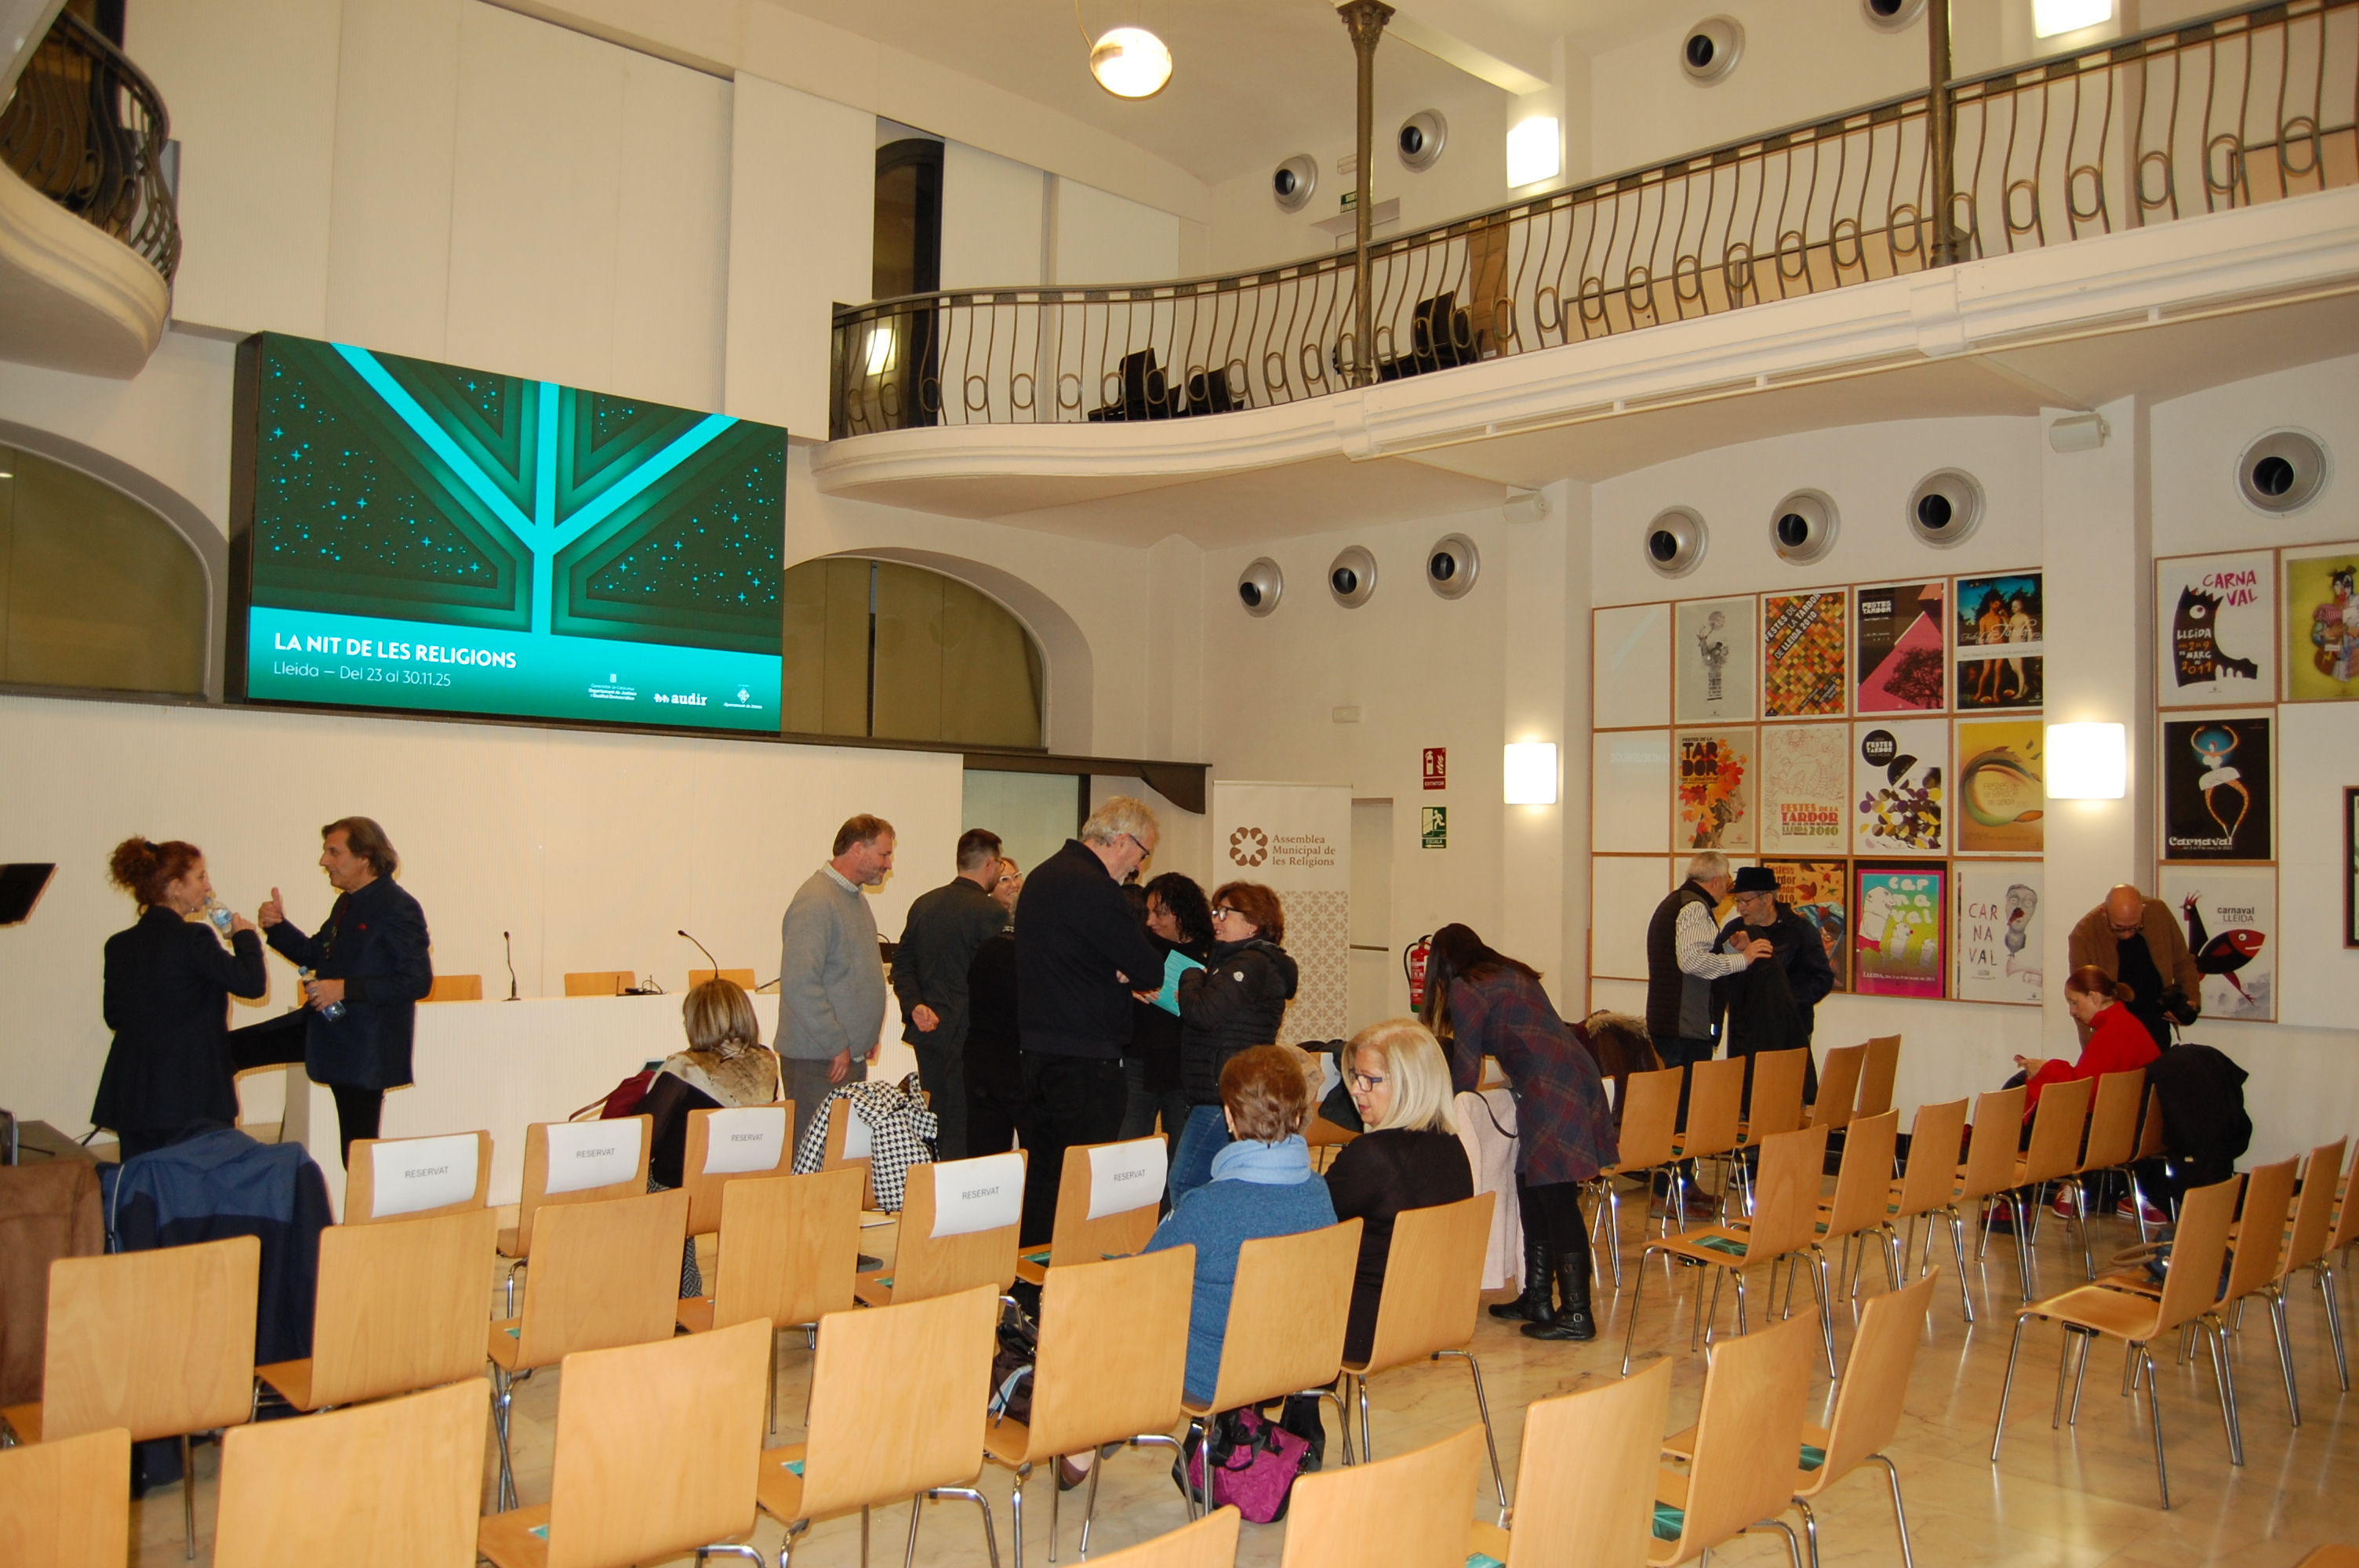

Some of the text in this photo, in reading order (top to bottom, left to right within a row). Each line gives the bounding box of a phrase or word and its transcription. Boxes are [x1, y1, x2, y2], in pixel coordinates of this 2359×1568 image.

[2202, 570, 2256, 590] CARNA
[2226, 589, 2258, 607] VAL
[1786, 604, 1797, 616] DE
[1862, 601, 1891, 609] FESTES
[1788, 619, 1798, 630] LA
[1774, 612, 1818, 659] DE LLEIDA 2010
[274, 632, 517, 669] LA NIT DE LES RELIGIONS
[2189, 642, 2195, 652] 2
[2203, 641, 2211, 651] 9
[2181, 661, 2212, 674] 2011
[274, 661, 319, 677] Lleida
[340, 666, 363, 681] Del
[367, 668, 383, 682] 23
[386, 670, 399, 684] al
[403, 670, 451, 687] 30.11.25
[671, 693, 707, 706] audir
[1682, 742, 1718, 759] TAR
[1682, 759, 1718, 776] DOR
[1781, 812, 1838, 822] TARDOR
[1808, 826, 1838, 836] 2010
[1272, 834, 1325, 844] Assemblea
[2168, 837, 2233, 846] Carnaval
[1272, 846, 1336, 857] Municipal de
[1272, 856, 1335, 868] les Religions
[1968, 903, 1998, 921] CAR
[1973, 924, 1993, 942] NA
[1968, 947, 1997, 966] VAL
[576, 1148, 615, 1158] RESERVAT
[405, 1166, 449, 1178] RESERVAT
[1114, 1169, 1146, 1181] RESERVAT
[962, 1186, 999, 1200] RESERVAT
